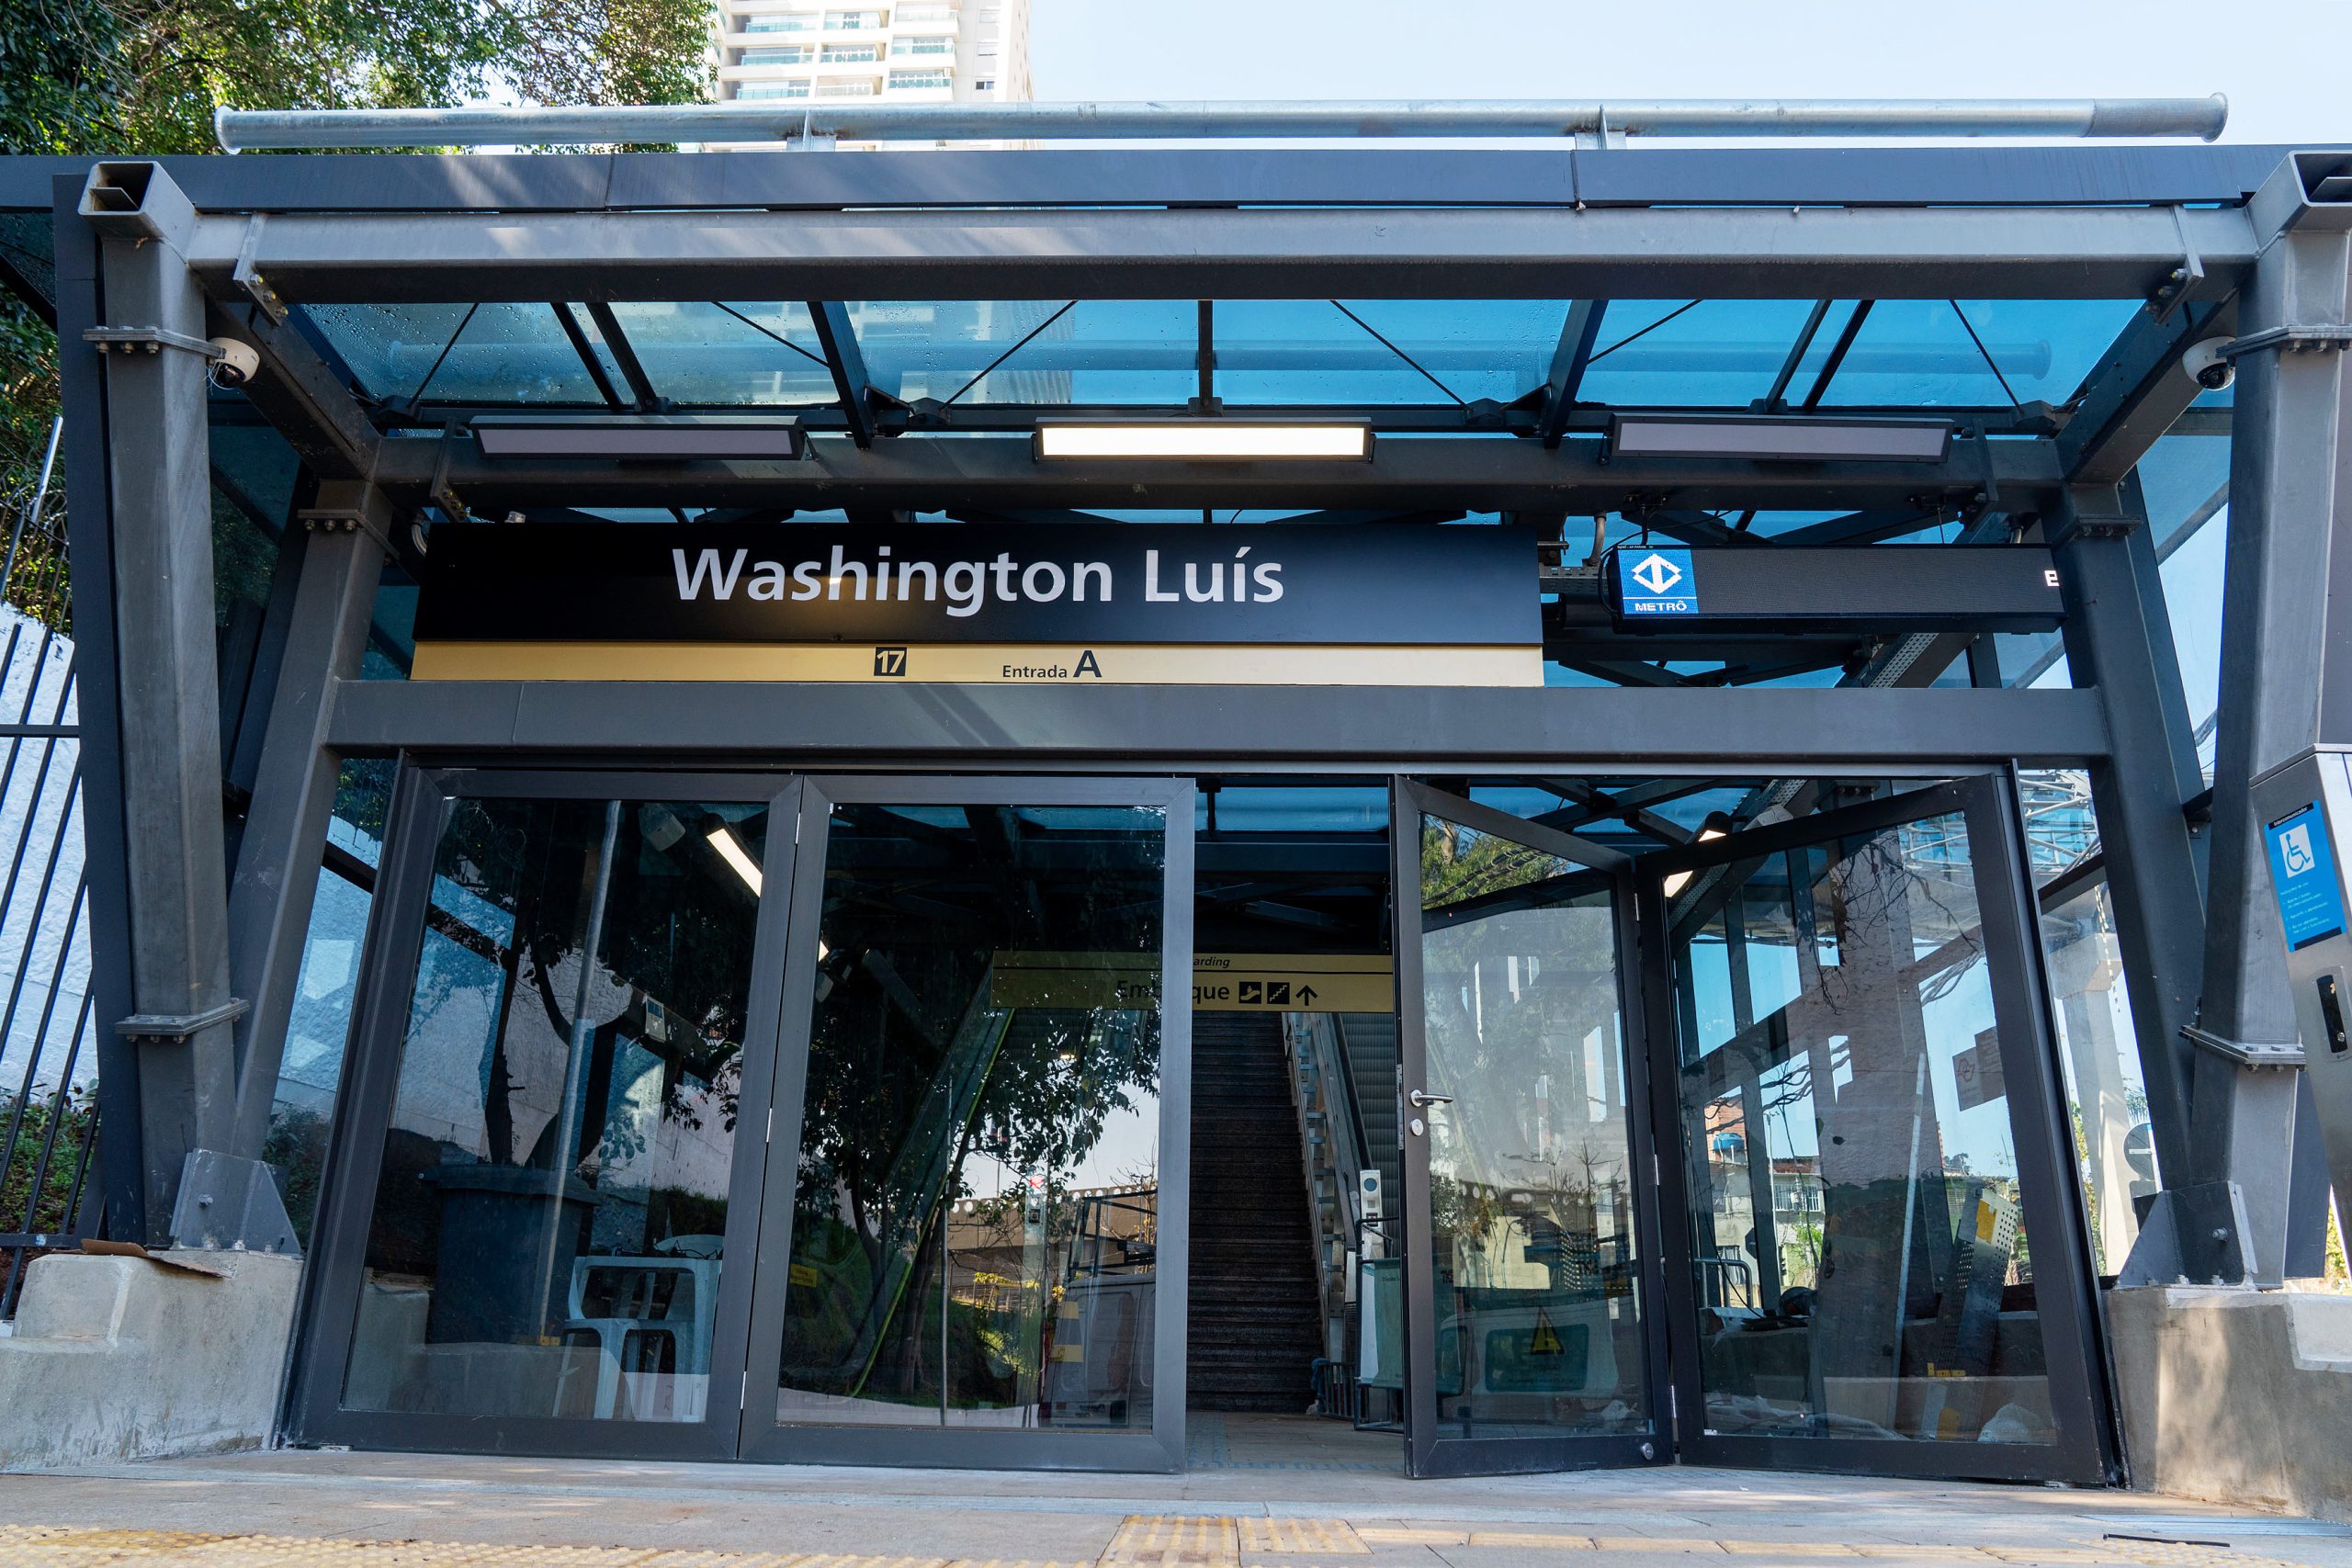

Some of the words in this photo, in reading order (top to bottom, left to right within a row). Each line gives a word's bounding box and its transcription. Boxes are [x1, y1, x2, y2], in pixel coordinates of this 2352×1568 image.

[672, 545, 1113, 617] Washington
[1145, 547, 1284, 604] Luís
[1634, 600, 1688, 612] METRÔ
[876, 650, 905, 673] 17
[1002, 664, 1068, 678] Entrada
[1072, 649, 1102, 678] A
[1193, 956, 1230, 969] arding
